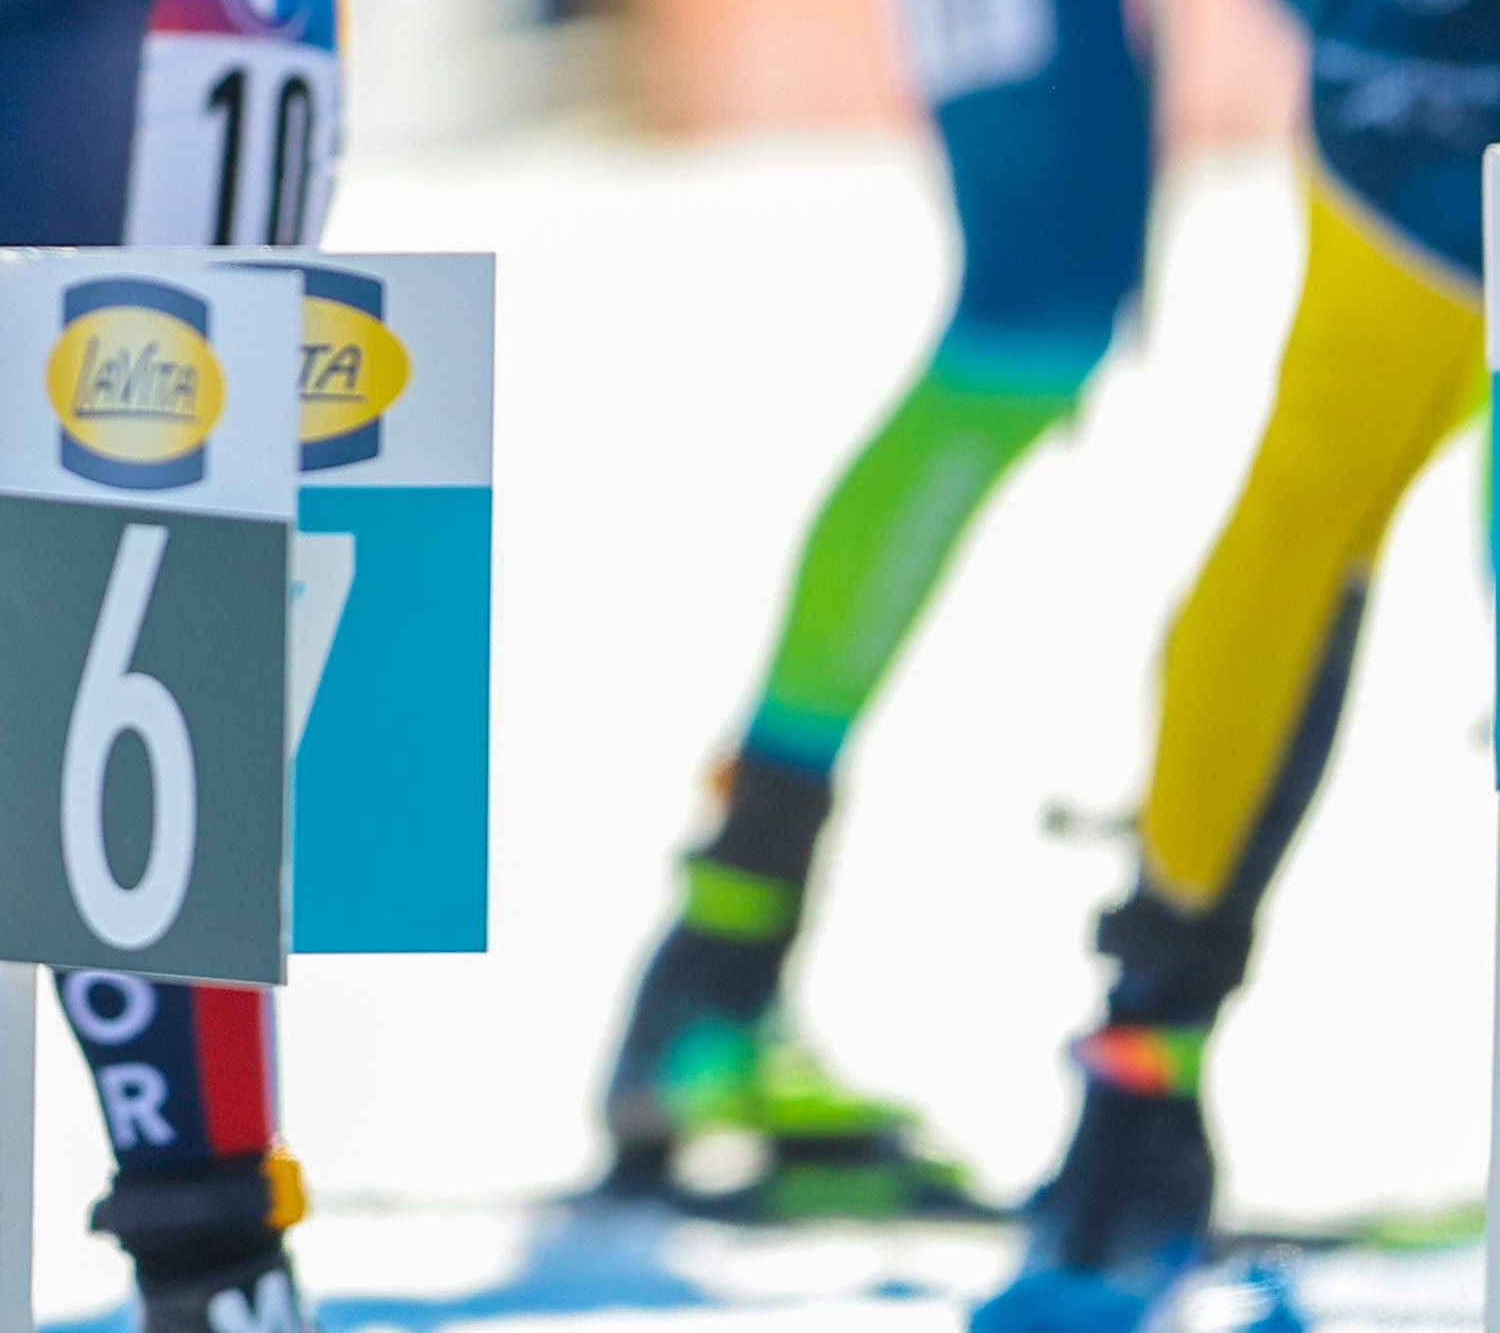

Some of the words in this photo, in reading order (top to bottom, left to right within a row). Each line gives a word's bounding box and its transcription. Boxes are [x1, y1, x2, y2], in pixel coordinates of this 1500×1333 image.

[207, 66, 315, 245] 10
[59, 523, 199, 951] 6
[64, 969, 178, 1150] OR
